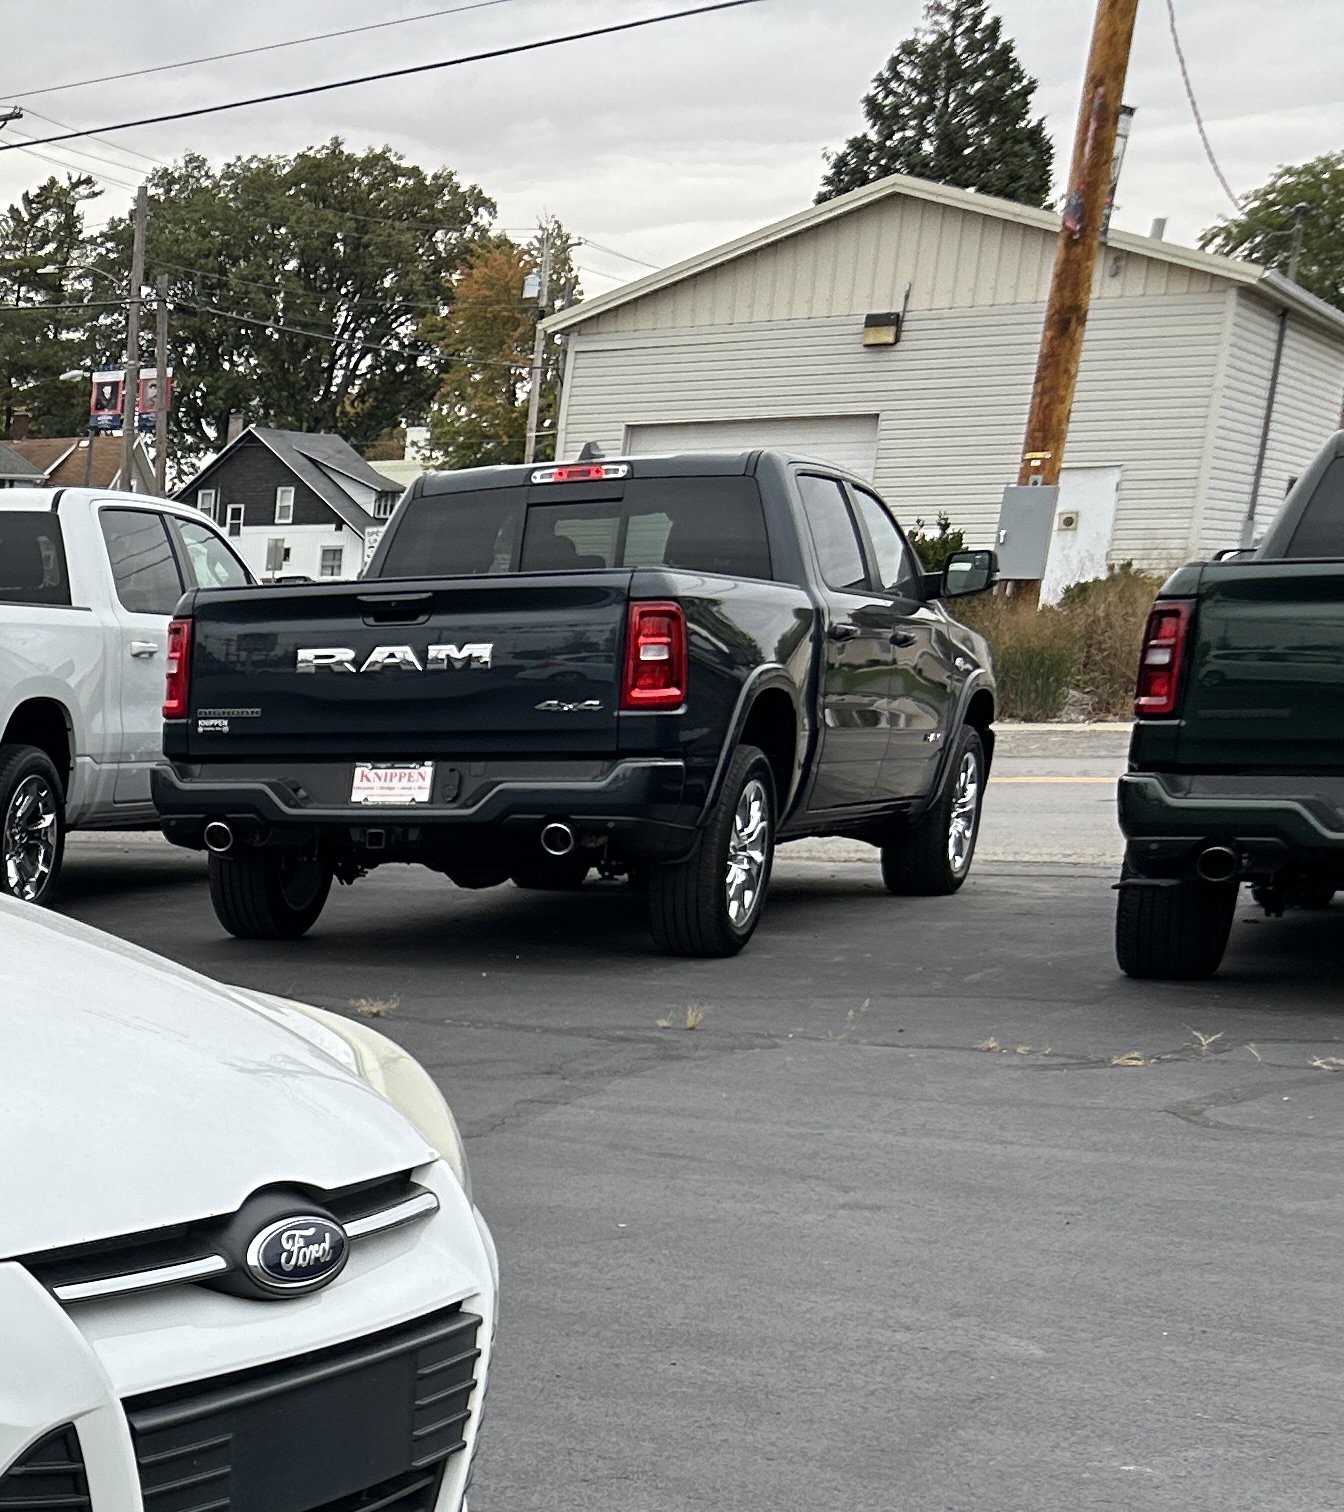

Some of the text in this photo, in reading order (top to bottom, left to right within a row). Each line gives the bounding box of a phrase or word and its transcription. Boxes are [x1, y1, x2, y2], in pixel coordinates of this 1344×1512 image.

[293, 643, 494, 673] RAM
[359, 769, 427, 783] KNIPPEN
[280, 1227, 333, 1272] Ford
